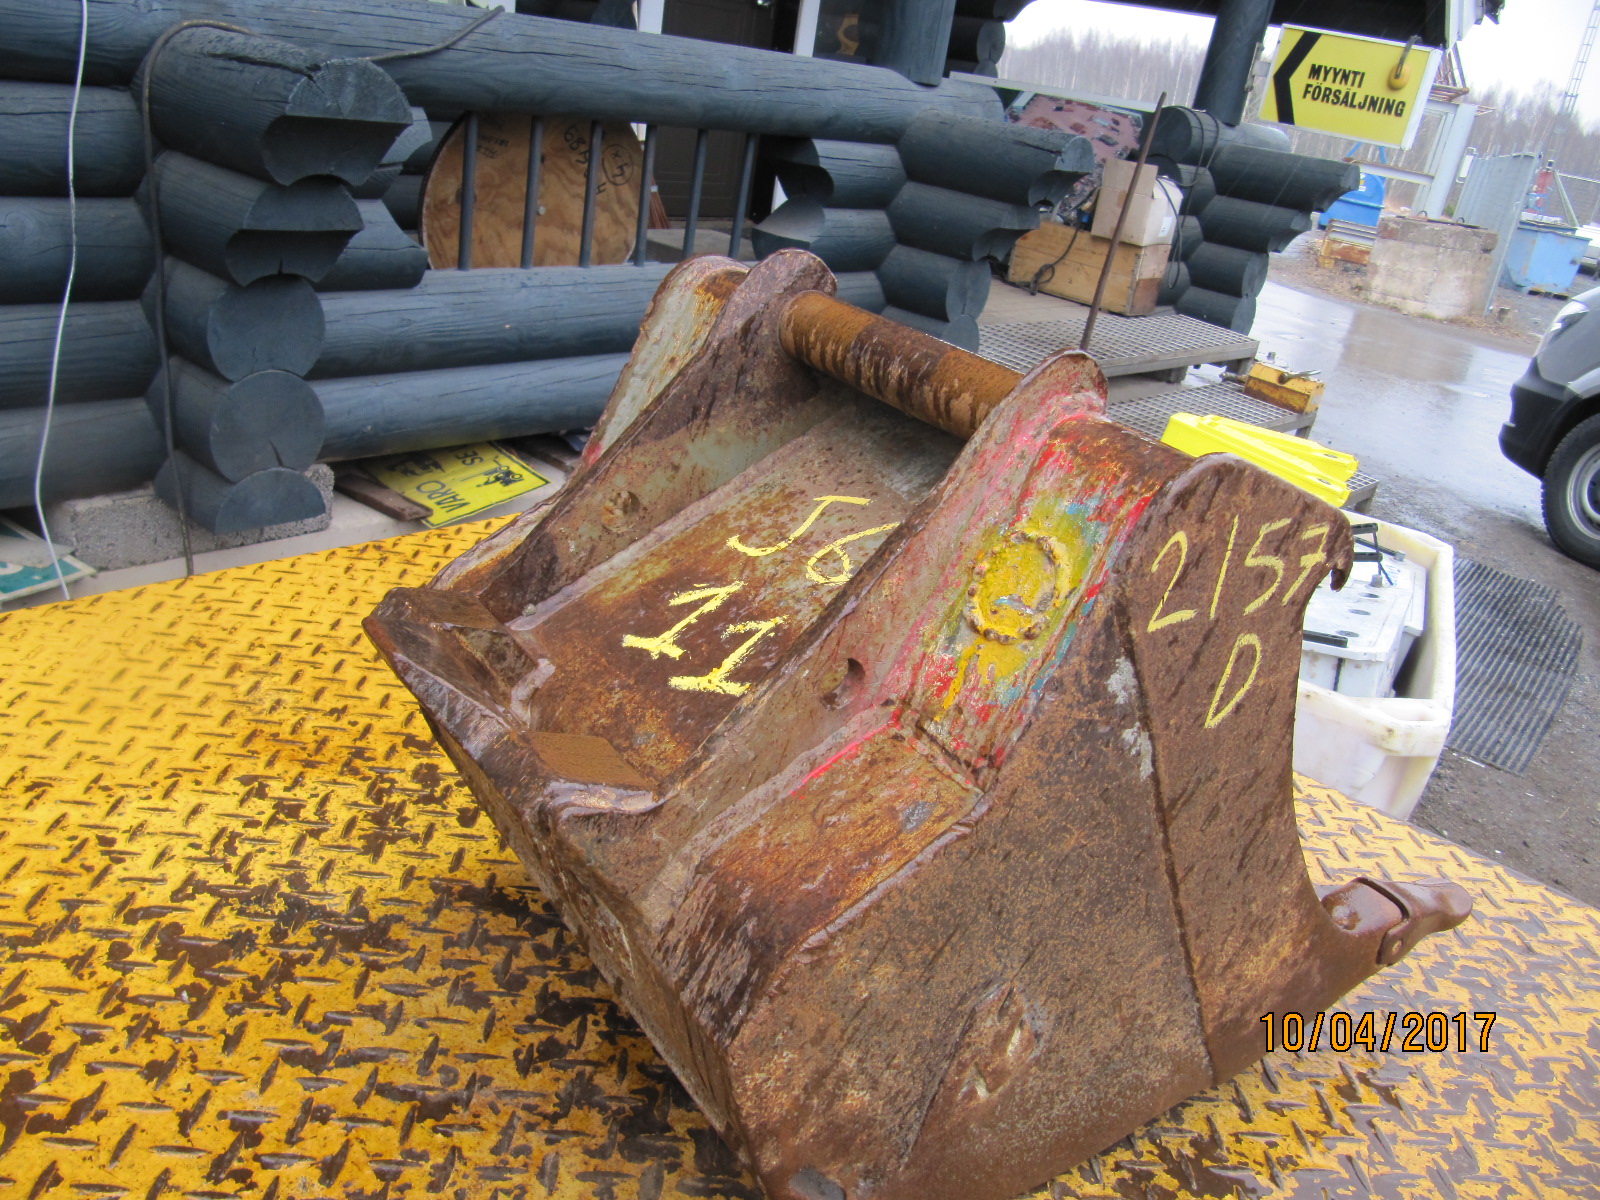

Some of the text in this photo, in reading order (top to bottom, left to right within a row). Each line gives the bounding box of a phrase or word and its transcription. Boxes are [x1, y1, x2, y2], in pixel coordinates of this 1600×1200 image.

[1307, 63, 1366, 89] MYYNTI
[1302, 82, 1407, 118] FÖRSÄLJNING
[416, 480, 471, 513] VARO
[1204, 632, 1262, 729] D
